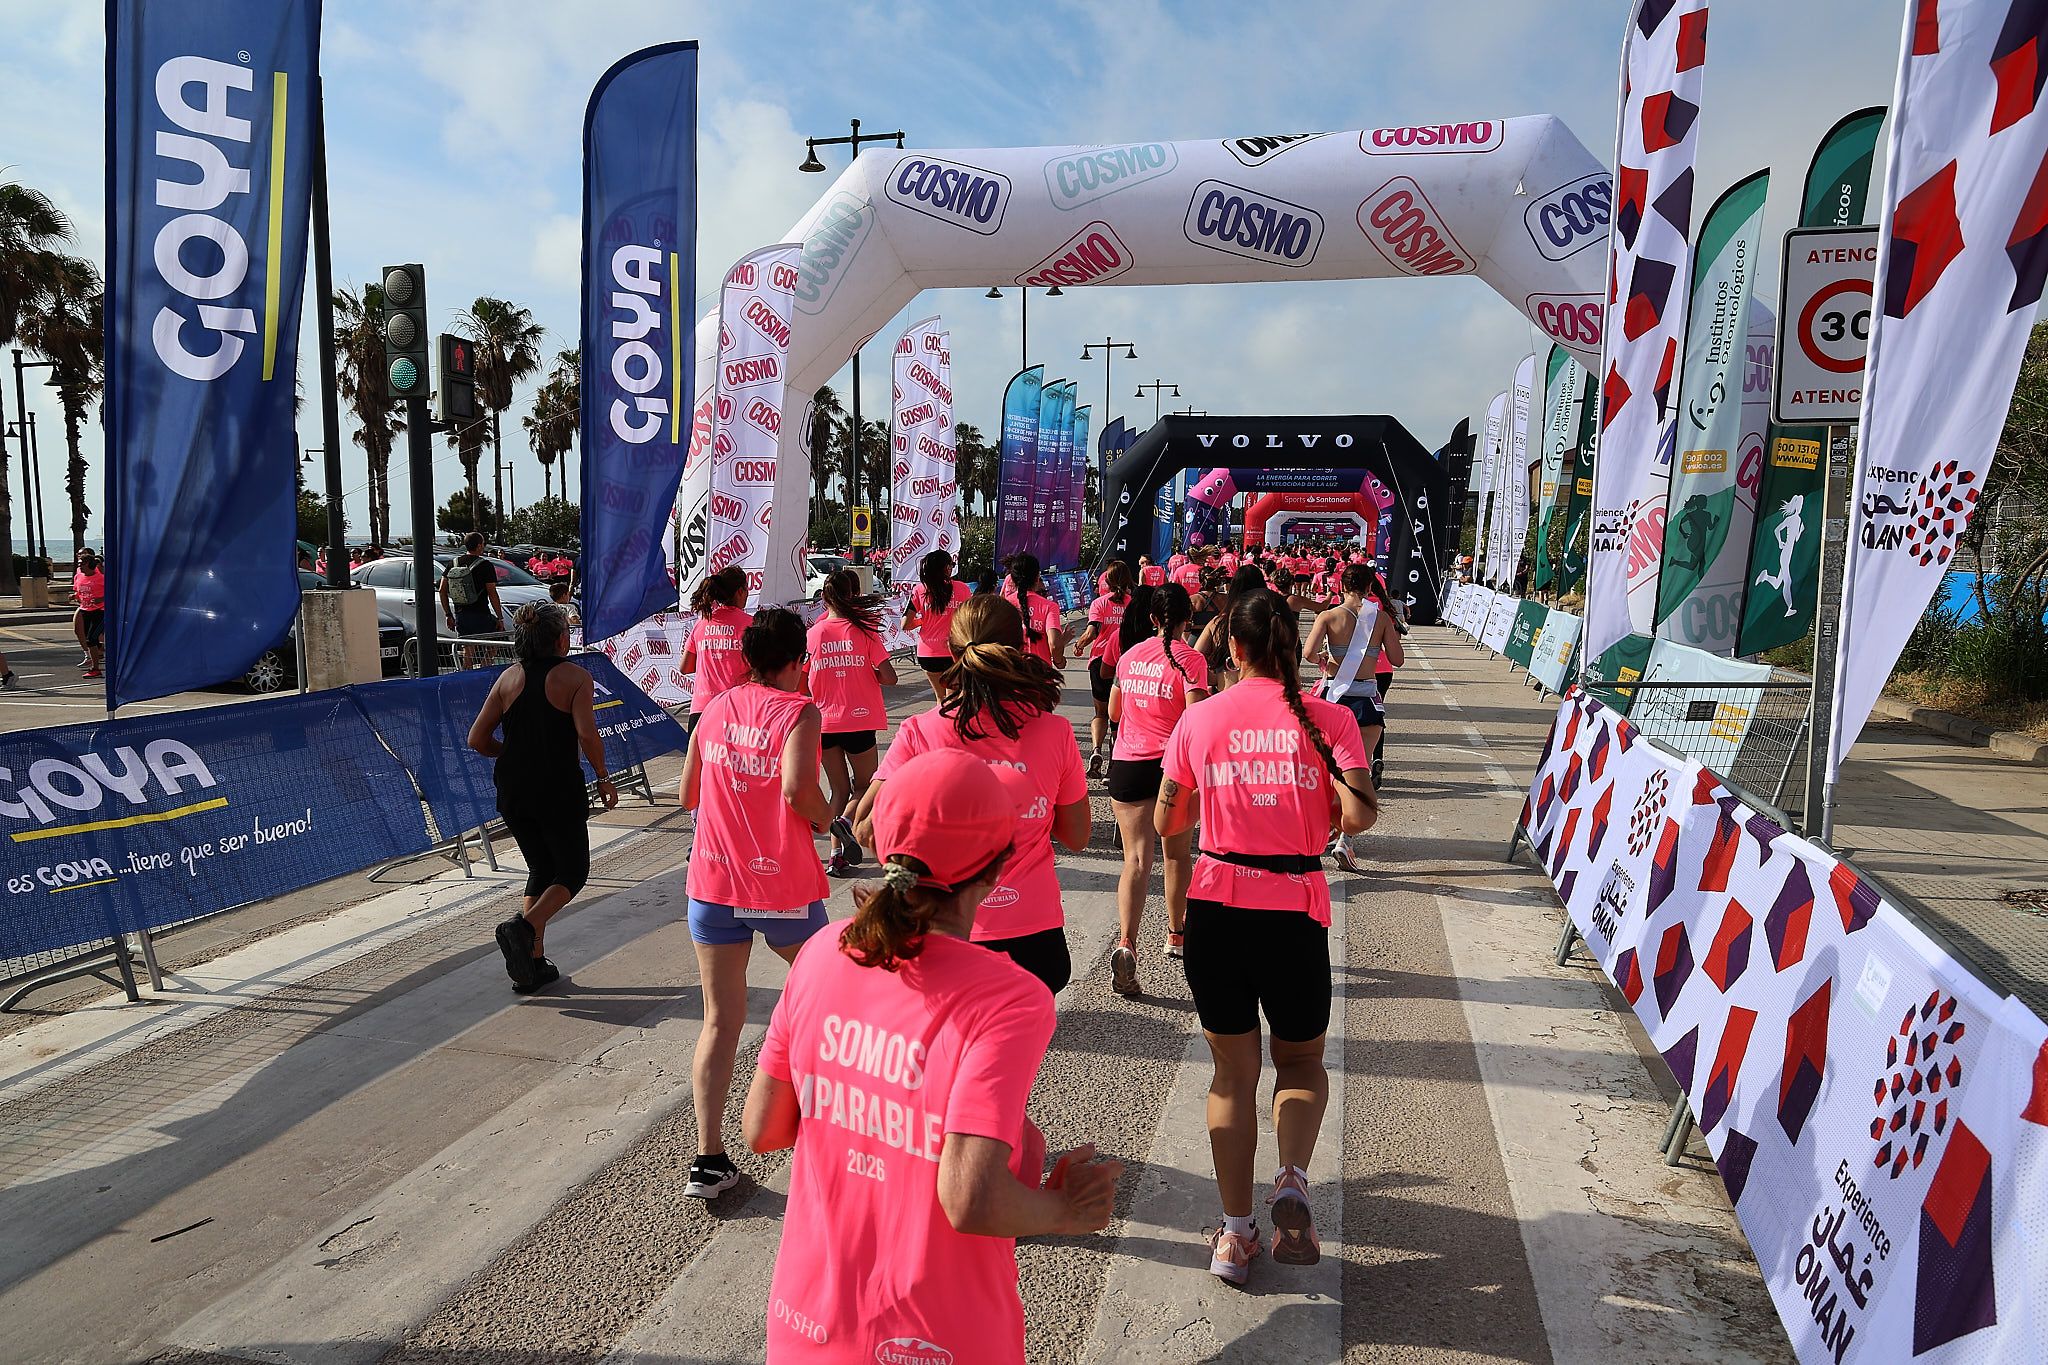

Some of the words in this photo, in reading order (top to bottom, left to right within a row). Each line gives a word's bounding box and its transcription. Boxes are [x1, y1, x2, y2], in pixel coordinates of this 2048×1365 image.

[1372, 121, 1492, 147] COSMO
[1056, 141, 1166, 187] COSMO
[899, 159, 1000, 224] COSMO
[153, 55, 257, 381] GOYA
[1197, 189, 1312, 261] COSMO
[1538, 180, 1613, 250] COS
[798, 200, 864, 304] COSMO
[1807, 246, 1878, 264] ATENC
[1537, 300, 1603, 344] COS
[1720, 239, 1746, 365] Odontológicos
[1705, 281, 1729, 364] Institutos
[610, 244, 669, 444] GOYA
[726, 356, 778, 386] COSMO
[900, 403, 934, 427] COSMO
[1790, 388, 1862, 405] ATENC
[1196, 433, 1354, 448] VOLVO
[1284, 496, 1306, 504] Sports
[1117, 491, 1131, 552] LVO
[646, 640, 671, 656] COSMO
[704, 625, 735, 637] SOMOS
[821, 639, 854, 654] SOMOS
[1128, 660, 1164, 678] SOMOS
[614, 722, 630, 742] que
[630, 716, 645, 730] ser
[1229, 728, 1300, 754] SOMOS
[705, 741, 780, 778] IMPARABLE
[1204, 759, 1320, 791] IMPARABLES
[0, 738, 217, 825] GOYA
[1252, 793, 1277, 806] 2026
[7, 873, 35, 894] es
[36, 857, 115, 889] GOYA
[180, 842, 215, 877] que
[219, 833, 250, 855] ser
[252, 808, 313, 846] bueno!
[1235, 867, 1263, 879] SHO
[1592, 902, 1618, 947] OMAN
[820, 1015, 926, 1090] SOMOS
[846, 1148, 886, 1182] 2026
[1834, 1158, 1892, 1262] Experience
[774, 1298, 829, 1345] OYSHO
[1795, 1243, 1855, 1365] OMAN
